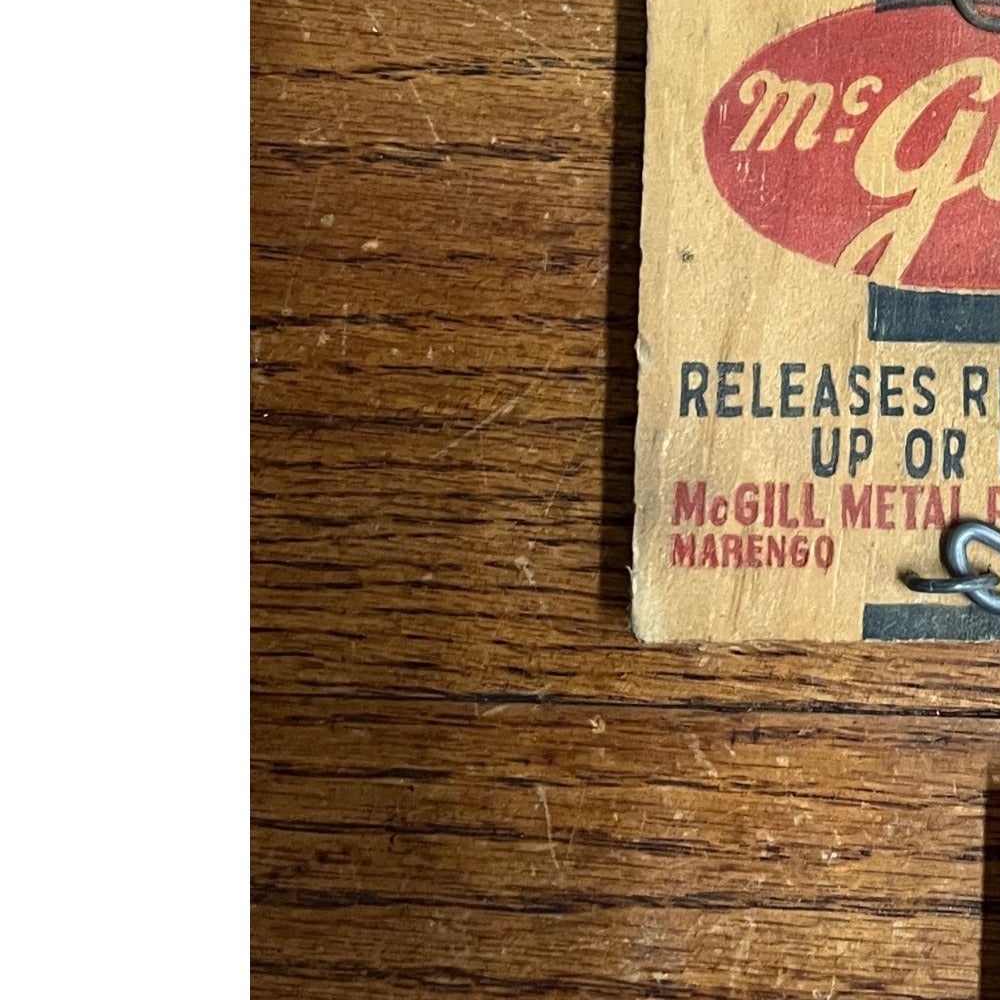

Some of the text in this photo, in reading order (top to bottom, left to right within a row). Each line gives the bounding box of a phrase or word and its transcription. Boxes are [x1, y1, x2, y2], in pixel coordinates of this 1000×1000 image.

[679, 361, 937, 419] RELEASES
[811, 426, 872, 479] UP
[904, 427, 968, 480] OR
[671, 480, 825, 530] McGILL
[670, 533, 836, 568] MARENGO
